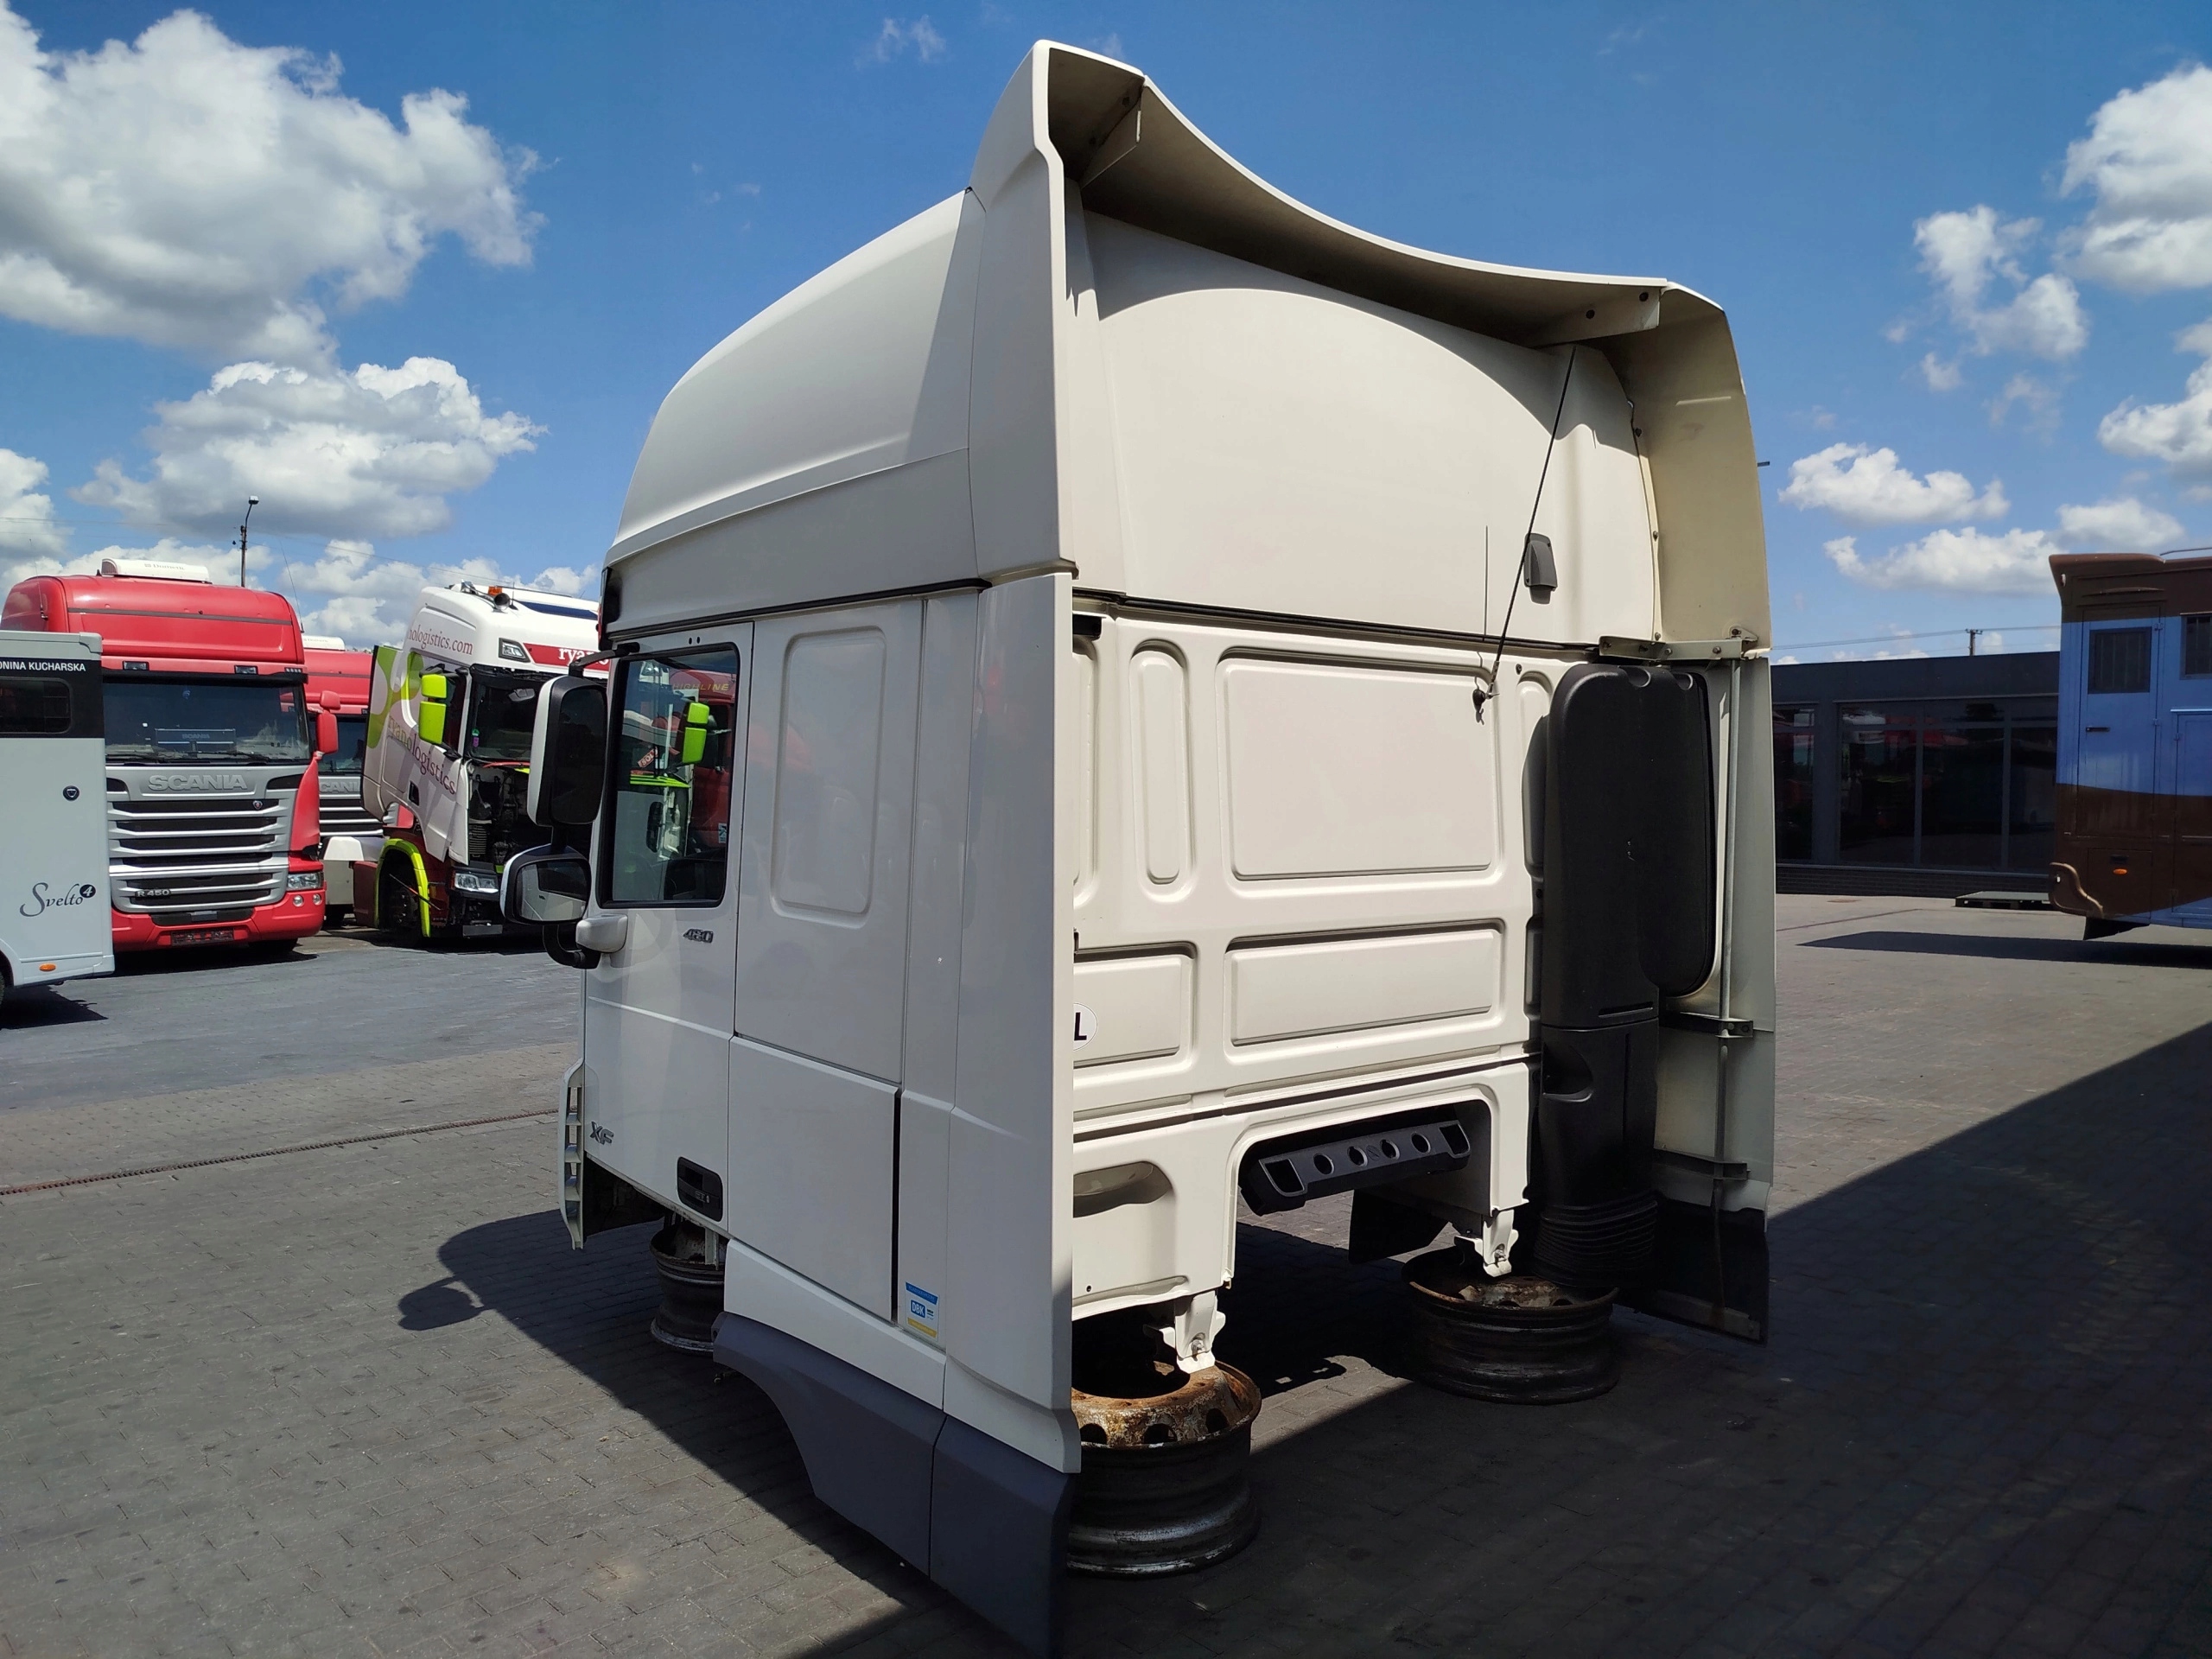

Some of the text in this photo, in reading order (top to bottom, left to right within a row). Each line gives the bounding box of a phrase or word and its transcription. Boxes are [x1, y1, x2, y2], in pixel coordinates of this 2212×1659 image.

[29, 662, 86, 671] KUCHARSKA
[388, 715, 456, 795] ryanologistics
[148, 774, 248, 791] SCANIA
[19, 882, 84, 918] Svelto
[589, 1121, 614, 1146] XF
[912, 1301, 925, 1317] DBK
